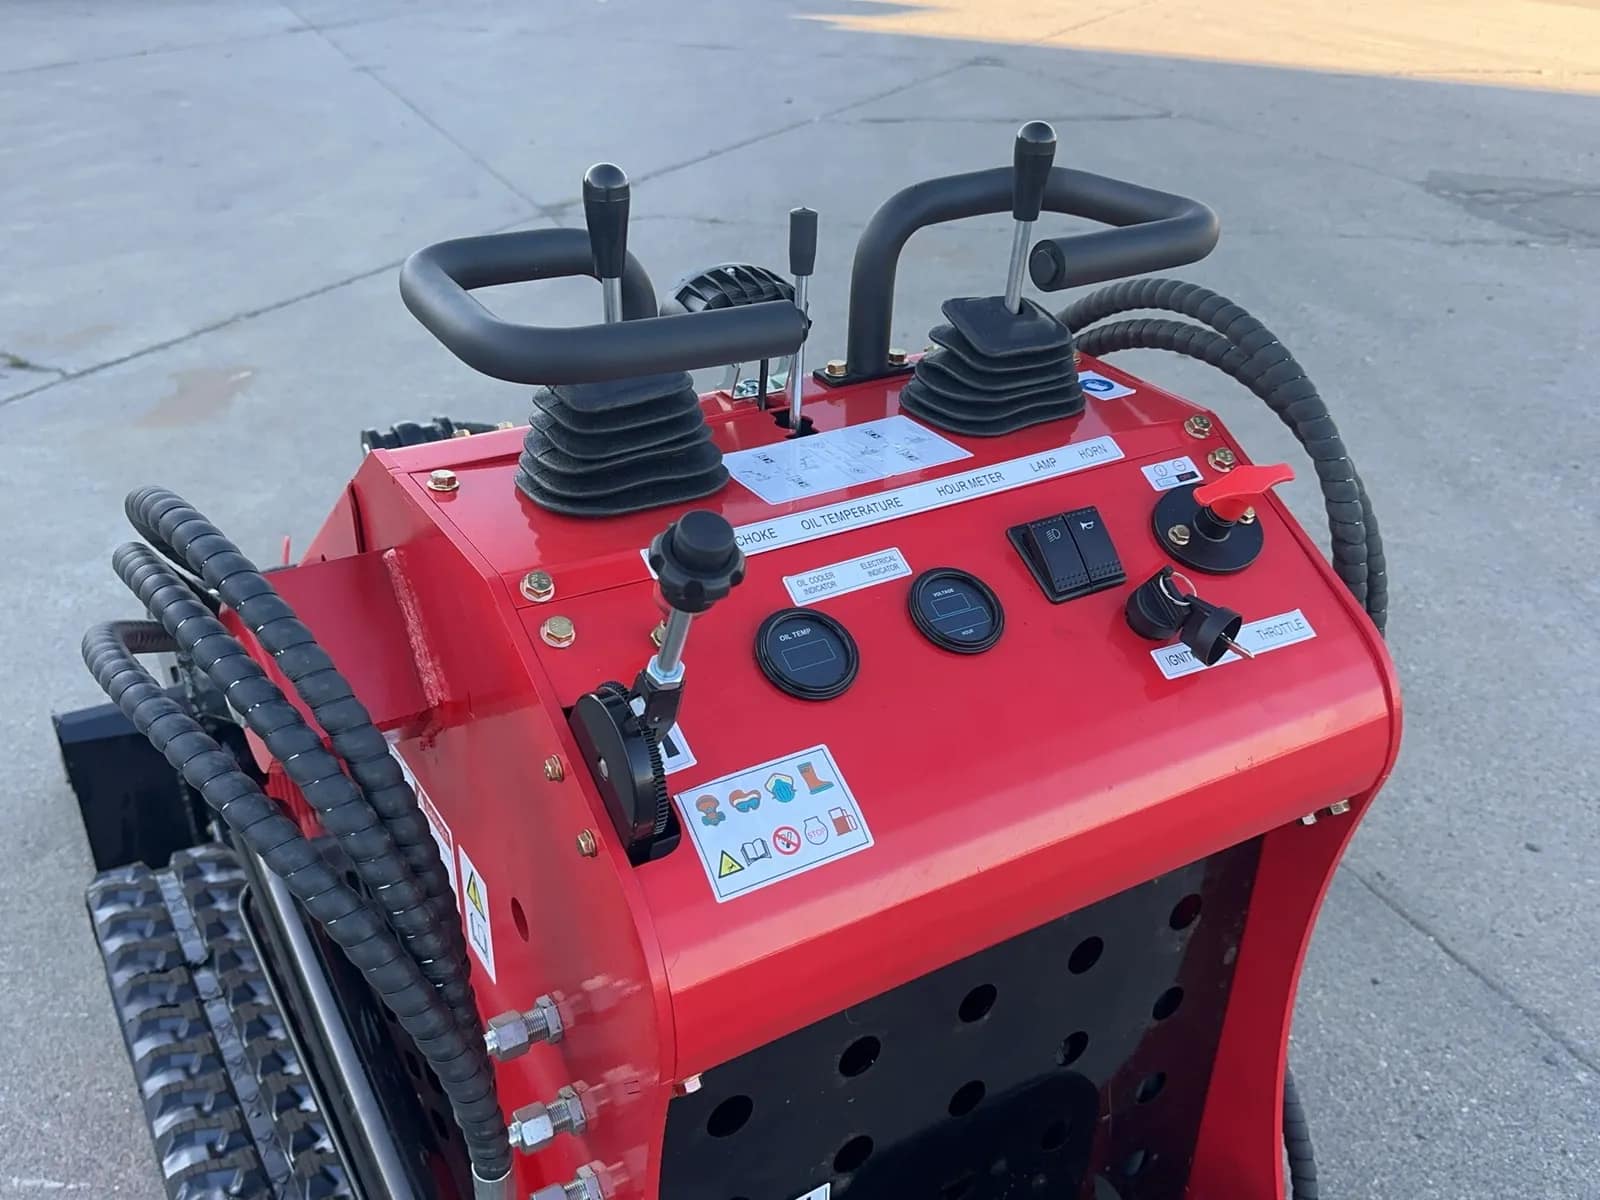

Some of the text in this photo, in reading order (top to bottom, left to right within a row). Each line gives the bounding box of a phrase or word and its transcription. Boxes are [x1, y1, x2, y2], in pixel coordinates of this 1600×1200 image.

[1078, 444, 1108, 460] HORN
[1030, 457, 1057, 473] LAMP
[936, 471, 1005, 497] HOUR METER
[800, 497, 904, 530] OIL TEMPERATURE
[735, 528, 778, 546] CHOKE
[860, 554, 897, 570] ELECTRICAL
[867, 562, 901, 577] INDICATOR
[796, 571, 836, 587] OIL COOLER
[803, 580, 838, 596] INDICATOR
[792, 627, 811, 638] TEMP
[1256, 618, 1305, 641] THROTTLE
[1165, 650, 1193, 667] IGNIT
[808, 827, 825, 839] STOP
